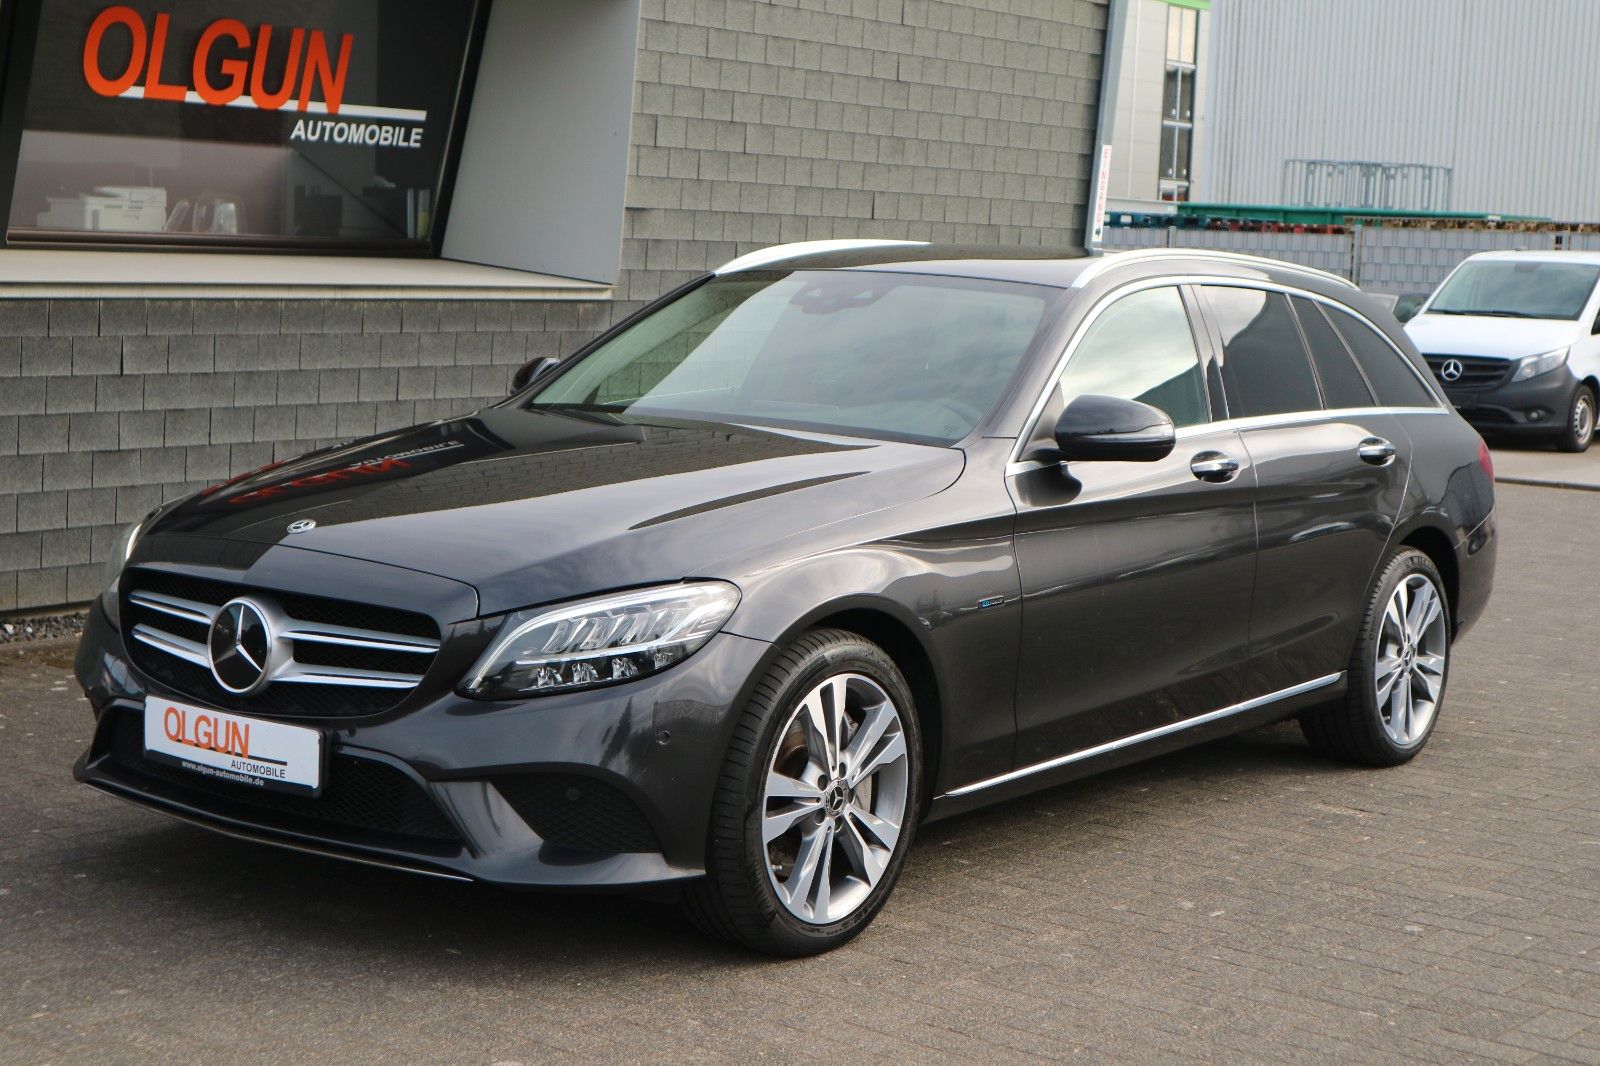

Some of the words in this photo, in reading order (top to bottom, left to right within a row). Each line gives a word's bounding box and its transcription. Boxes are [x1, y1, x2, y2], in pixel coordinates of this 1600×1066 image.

[83, 5, 354, 114] OLGUN
[290, 119, 424, 148] AUTOMOBILE
[164, 707, 249, 757] OLGUN
[181, 760, 265, 786] www.olgun-automobile.de
[231, 759, 286, 778] AUTOMOBILE
